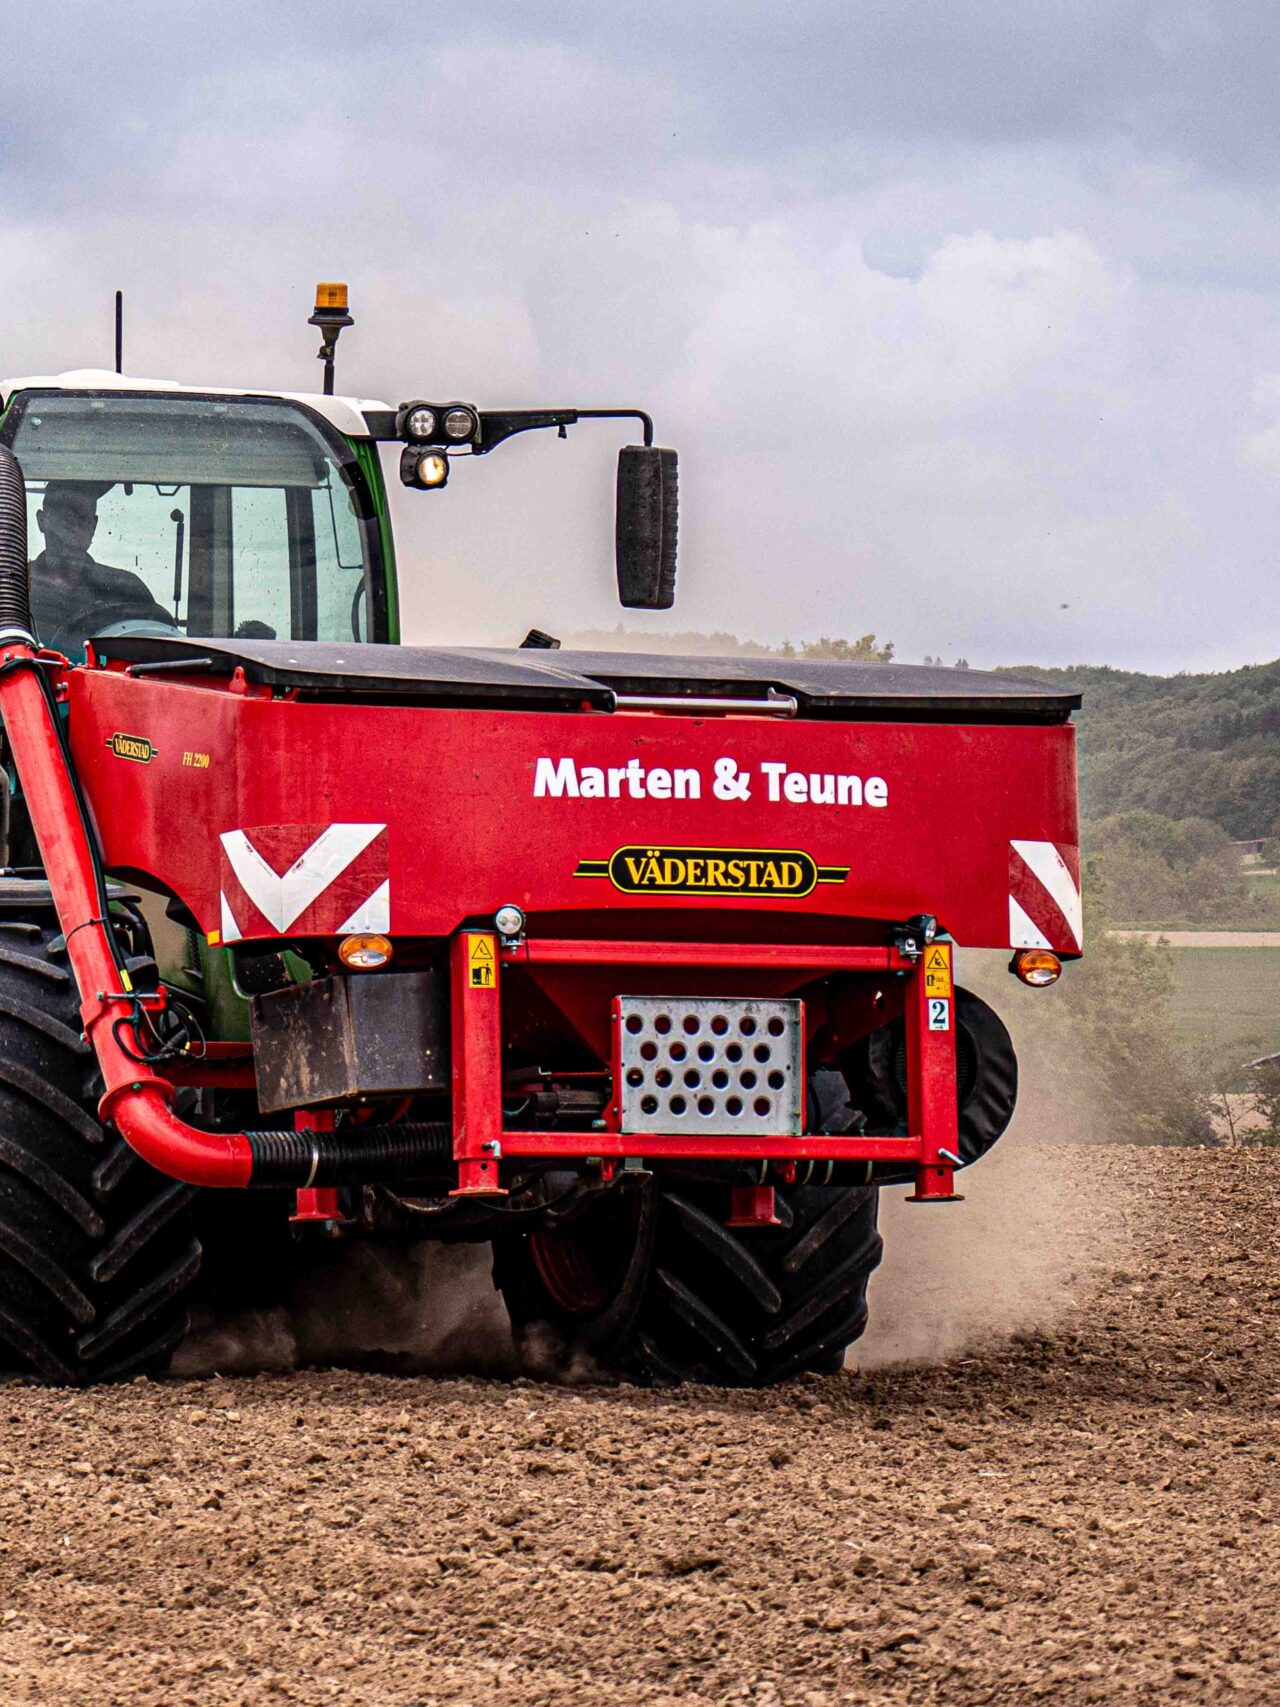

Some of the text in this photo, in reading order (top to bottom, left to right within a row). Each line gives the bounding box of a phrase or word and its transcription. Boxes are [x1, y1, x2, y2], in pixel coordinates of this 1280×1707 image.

[115, 736, 150, 759] VÄDERSTAD
[182, 751, 192, 766] FH
[533, 757, 889, 808] Marten & Teune
[624, 850, 803, 889] VÄDERSTAD
[932, 1001, 946, 1024] 2
